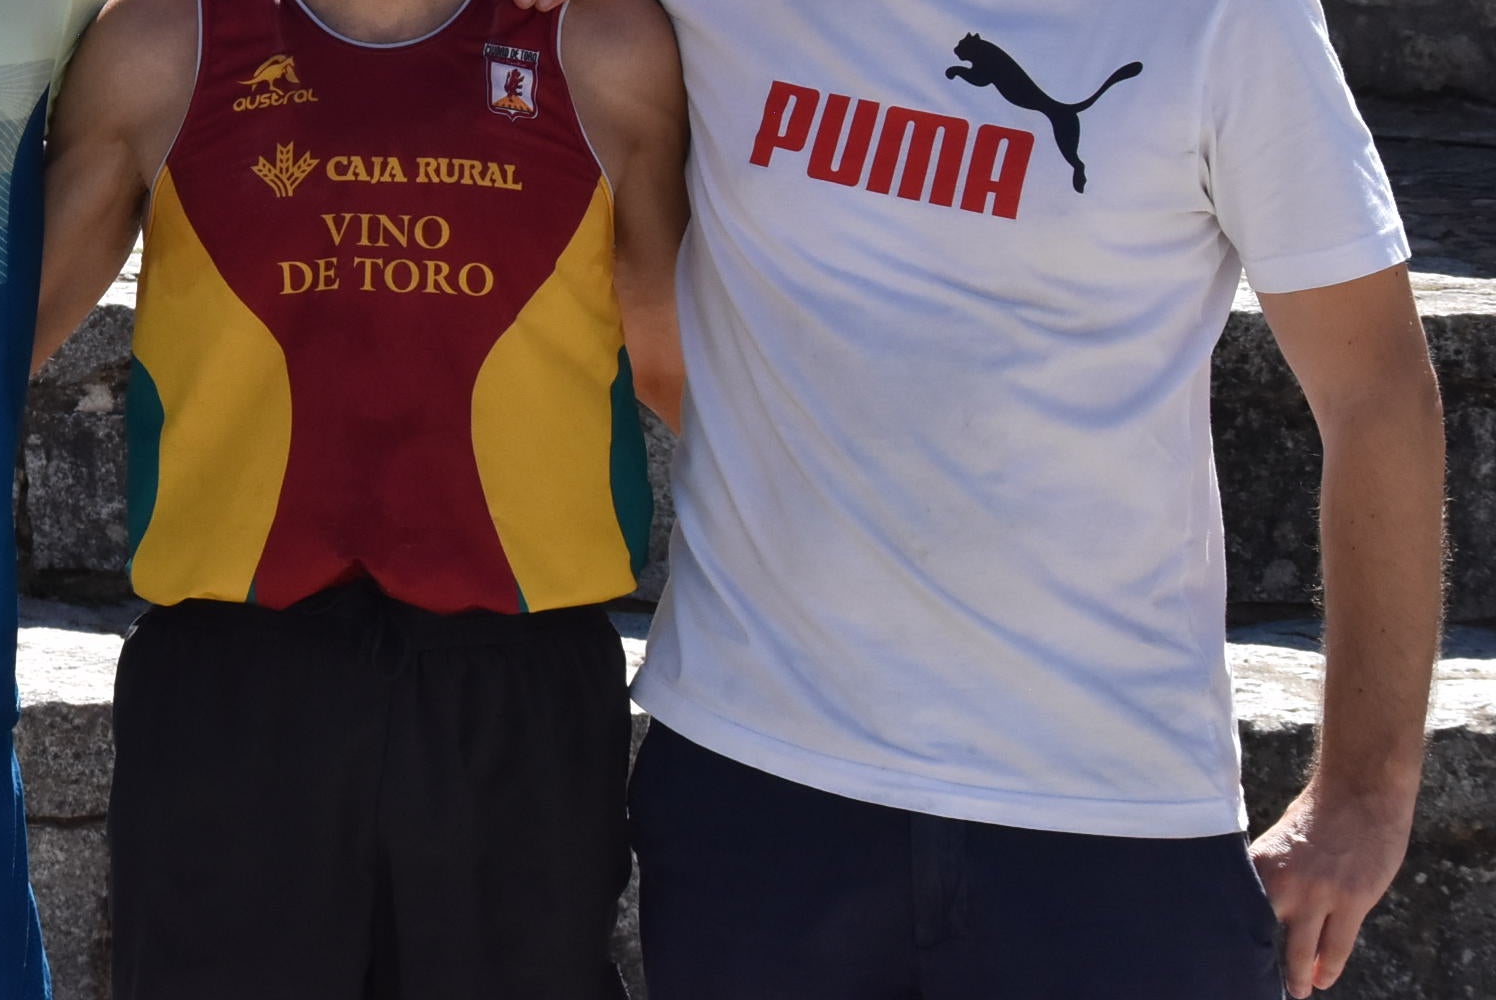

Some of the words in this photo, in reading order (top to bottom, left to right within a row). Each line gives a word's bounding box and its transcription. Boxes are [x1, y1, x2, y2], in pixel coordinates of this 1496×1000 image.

[749, 80, 1035, 220] PUMA
[326, 155, 408, 184] CAJA
[416, 156, 523, 191] RURAL
[321, 212, 451, 250] VINO
[277, 257, 340, 295] DE
[354, 255, 494, 297] TORO
